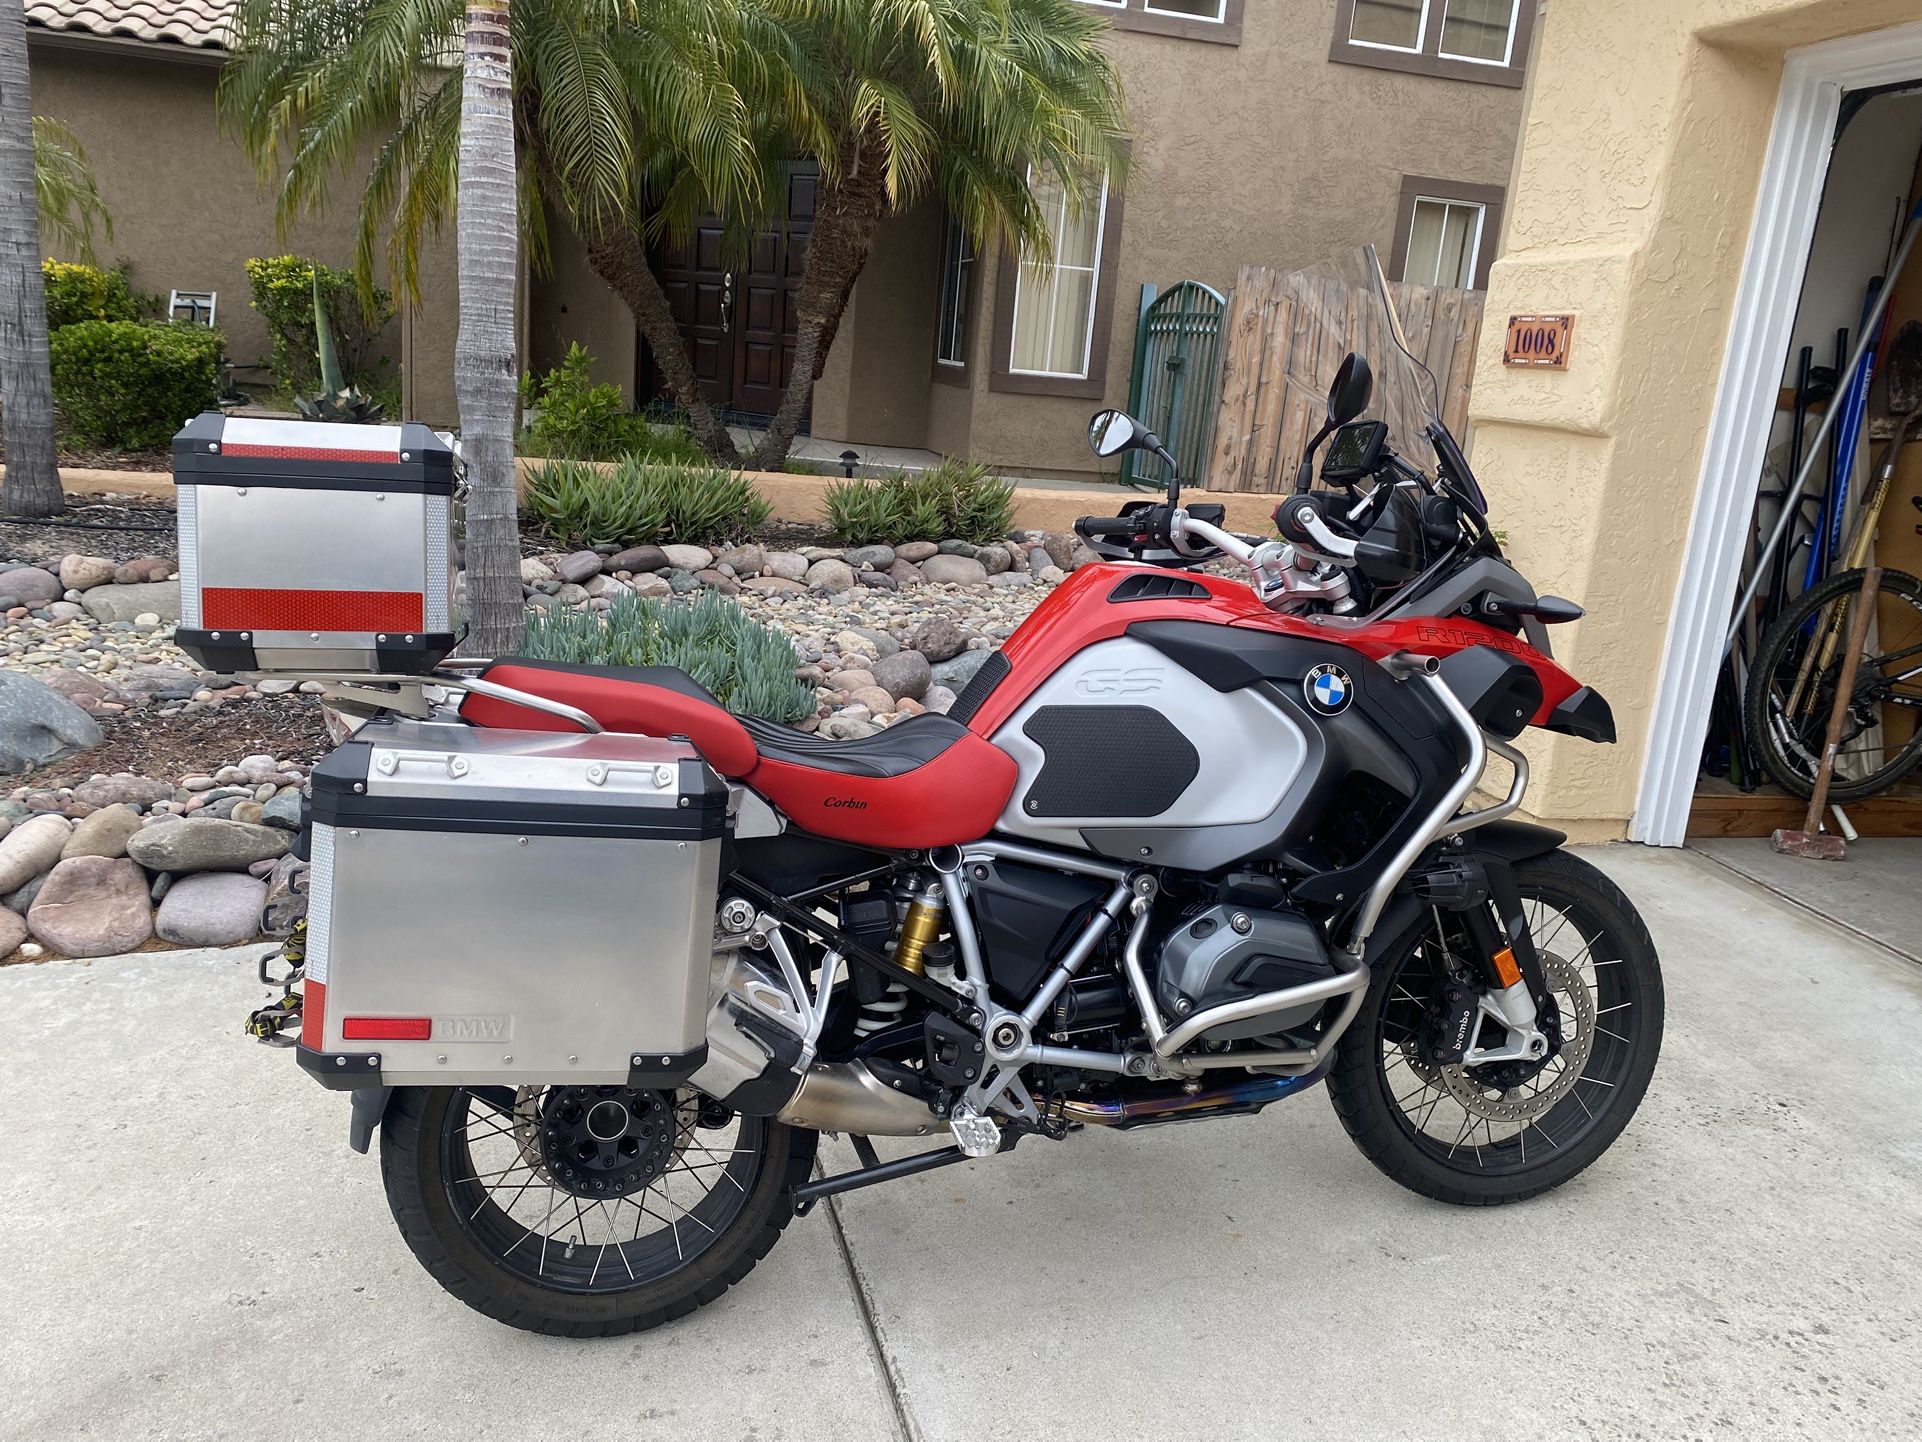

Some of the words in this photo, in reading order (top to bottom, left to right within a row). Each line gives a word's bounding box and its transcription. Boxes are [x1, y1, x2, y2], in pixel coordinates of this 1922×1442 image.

[1513, 328, 1557, 355] 1008
[1075, 668, 1165, 698] GS
[1311, 665, 1351, 685] BMW
[823, 796, 868, 810] Corbin
[439, 1018, 506, 1038] BMW
[1452, 1010, 1470, 1050] brembo
